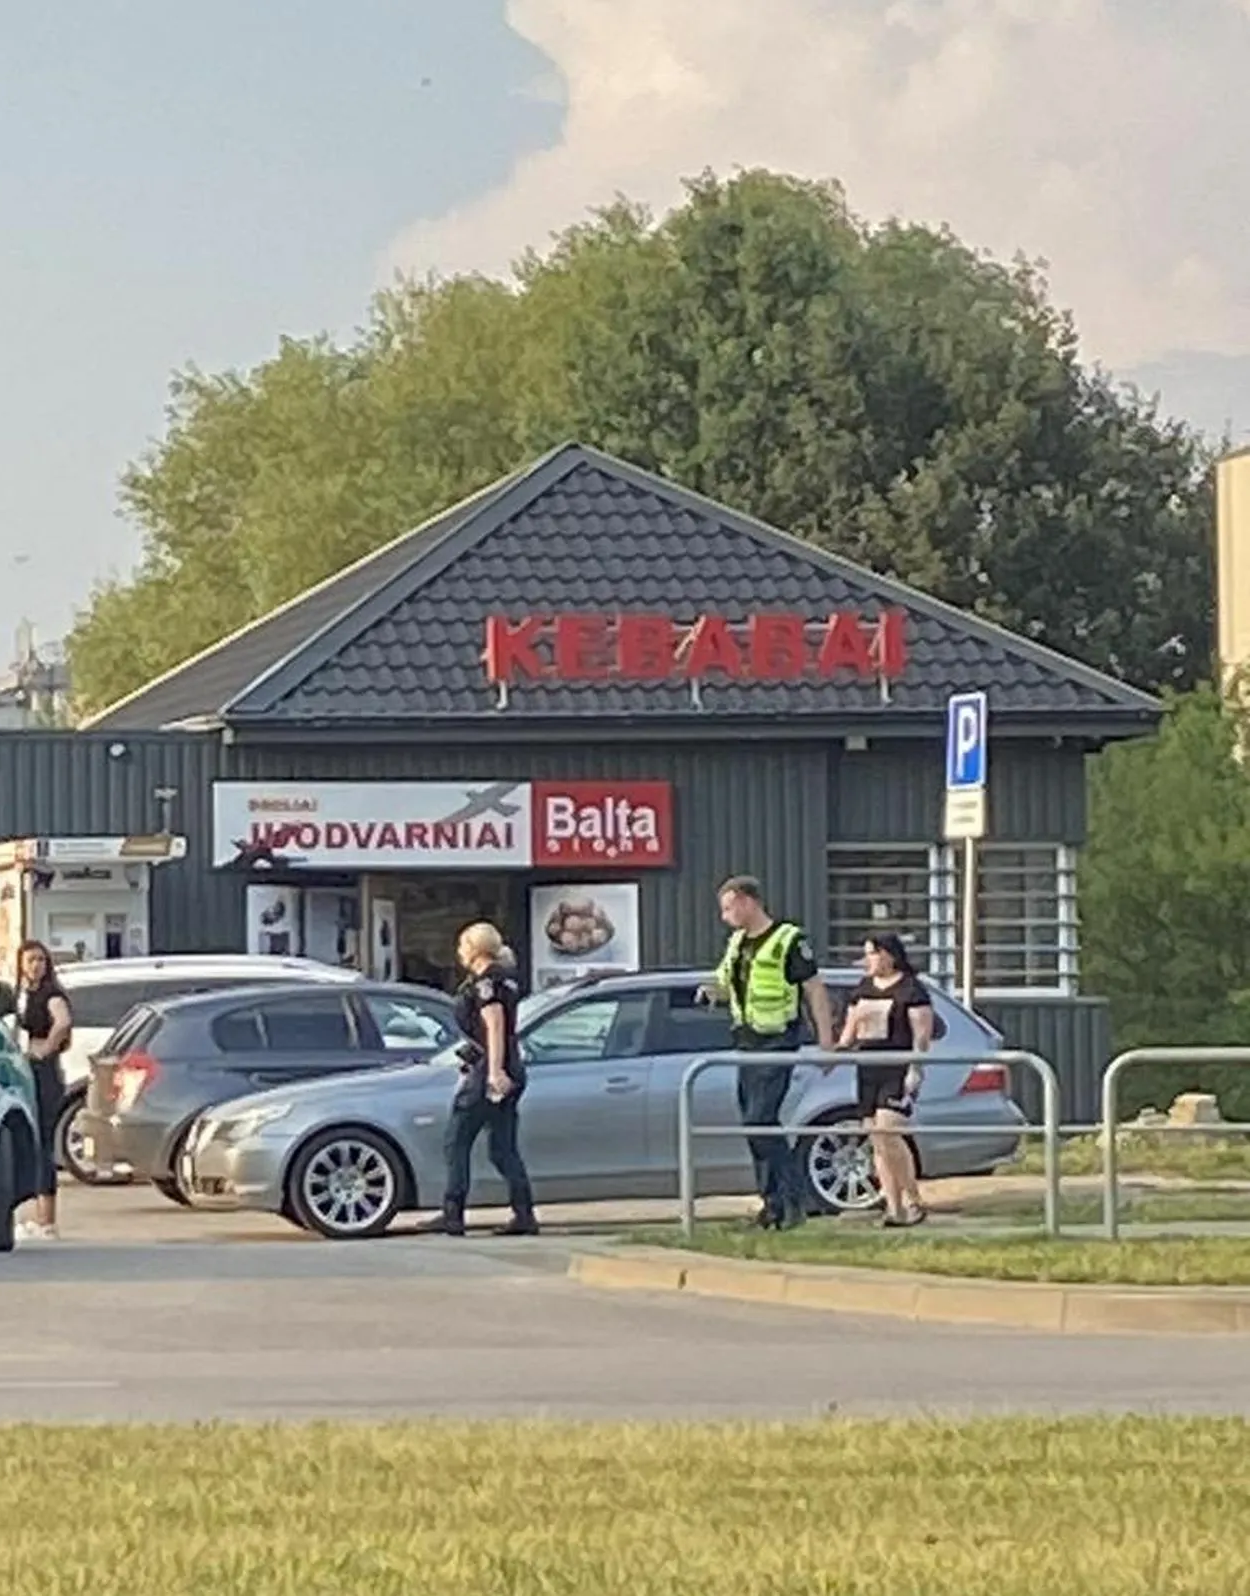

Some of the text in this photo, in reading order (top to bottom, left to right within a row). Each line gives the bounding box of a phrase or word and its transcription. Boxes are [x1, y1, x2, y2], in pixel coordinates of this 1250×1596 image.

[485, 608, 908, 681] KEBABAI
[957, 706, 978, 779] P
[546, 797, 656, 839] Balta
